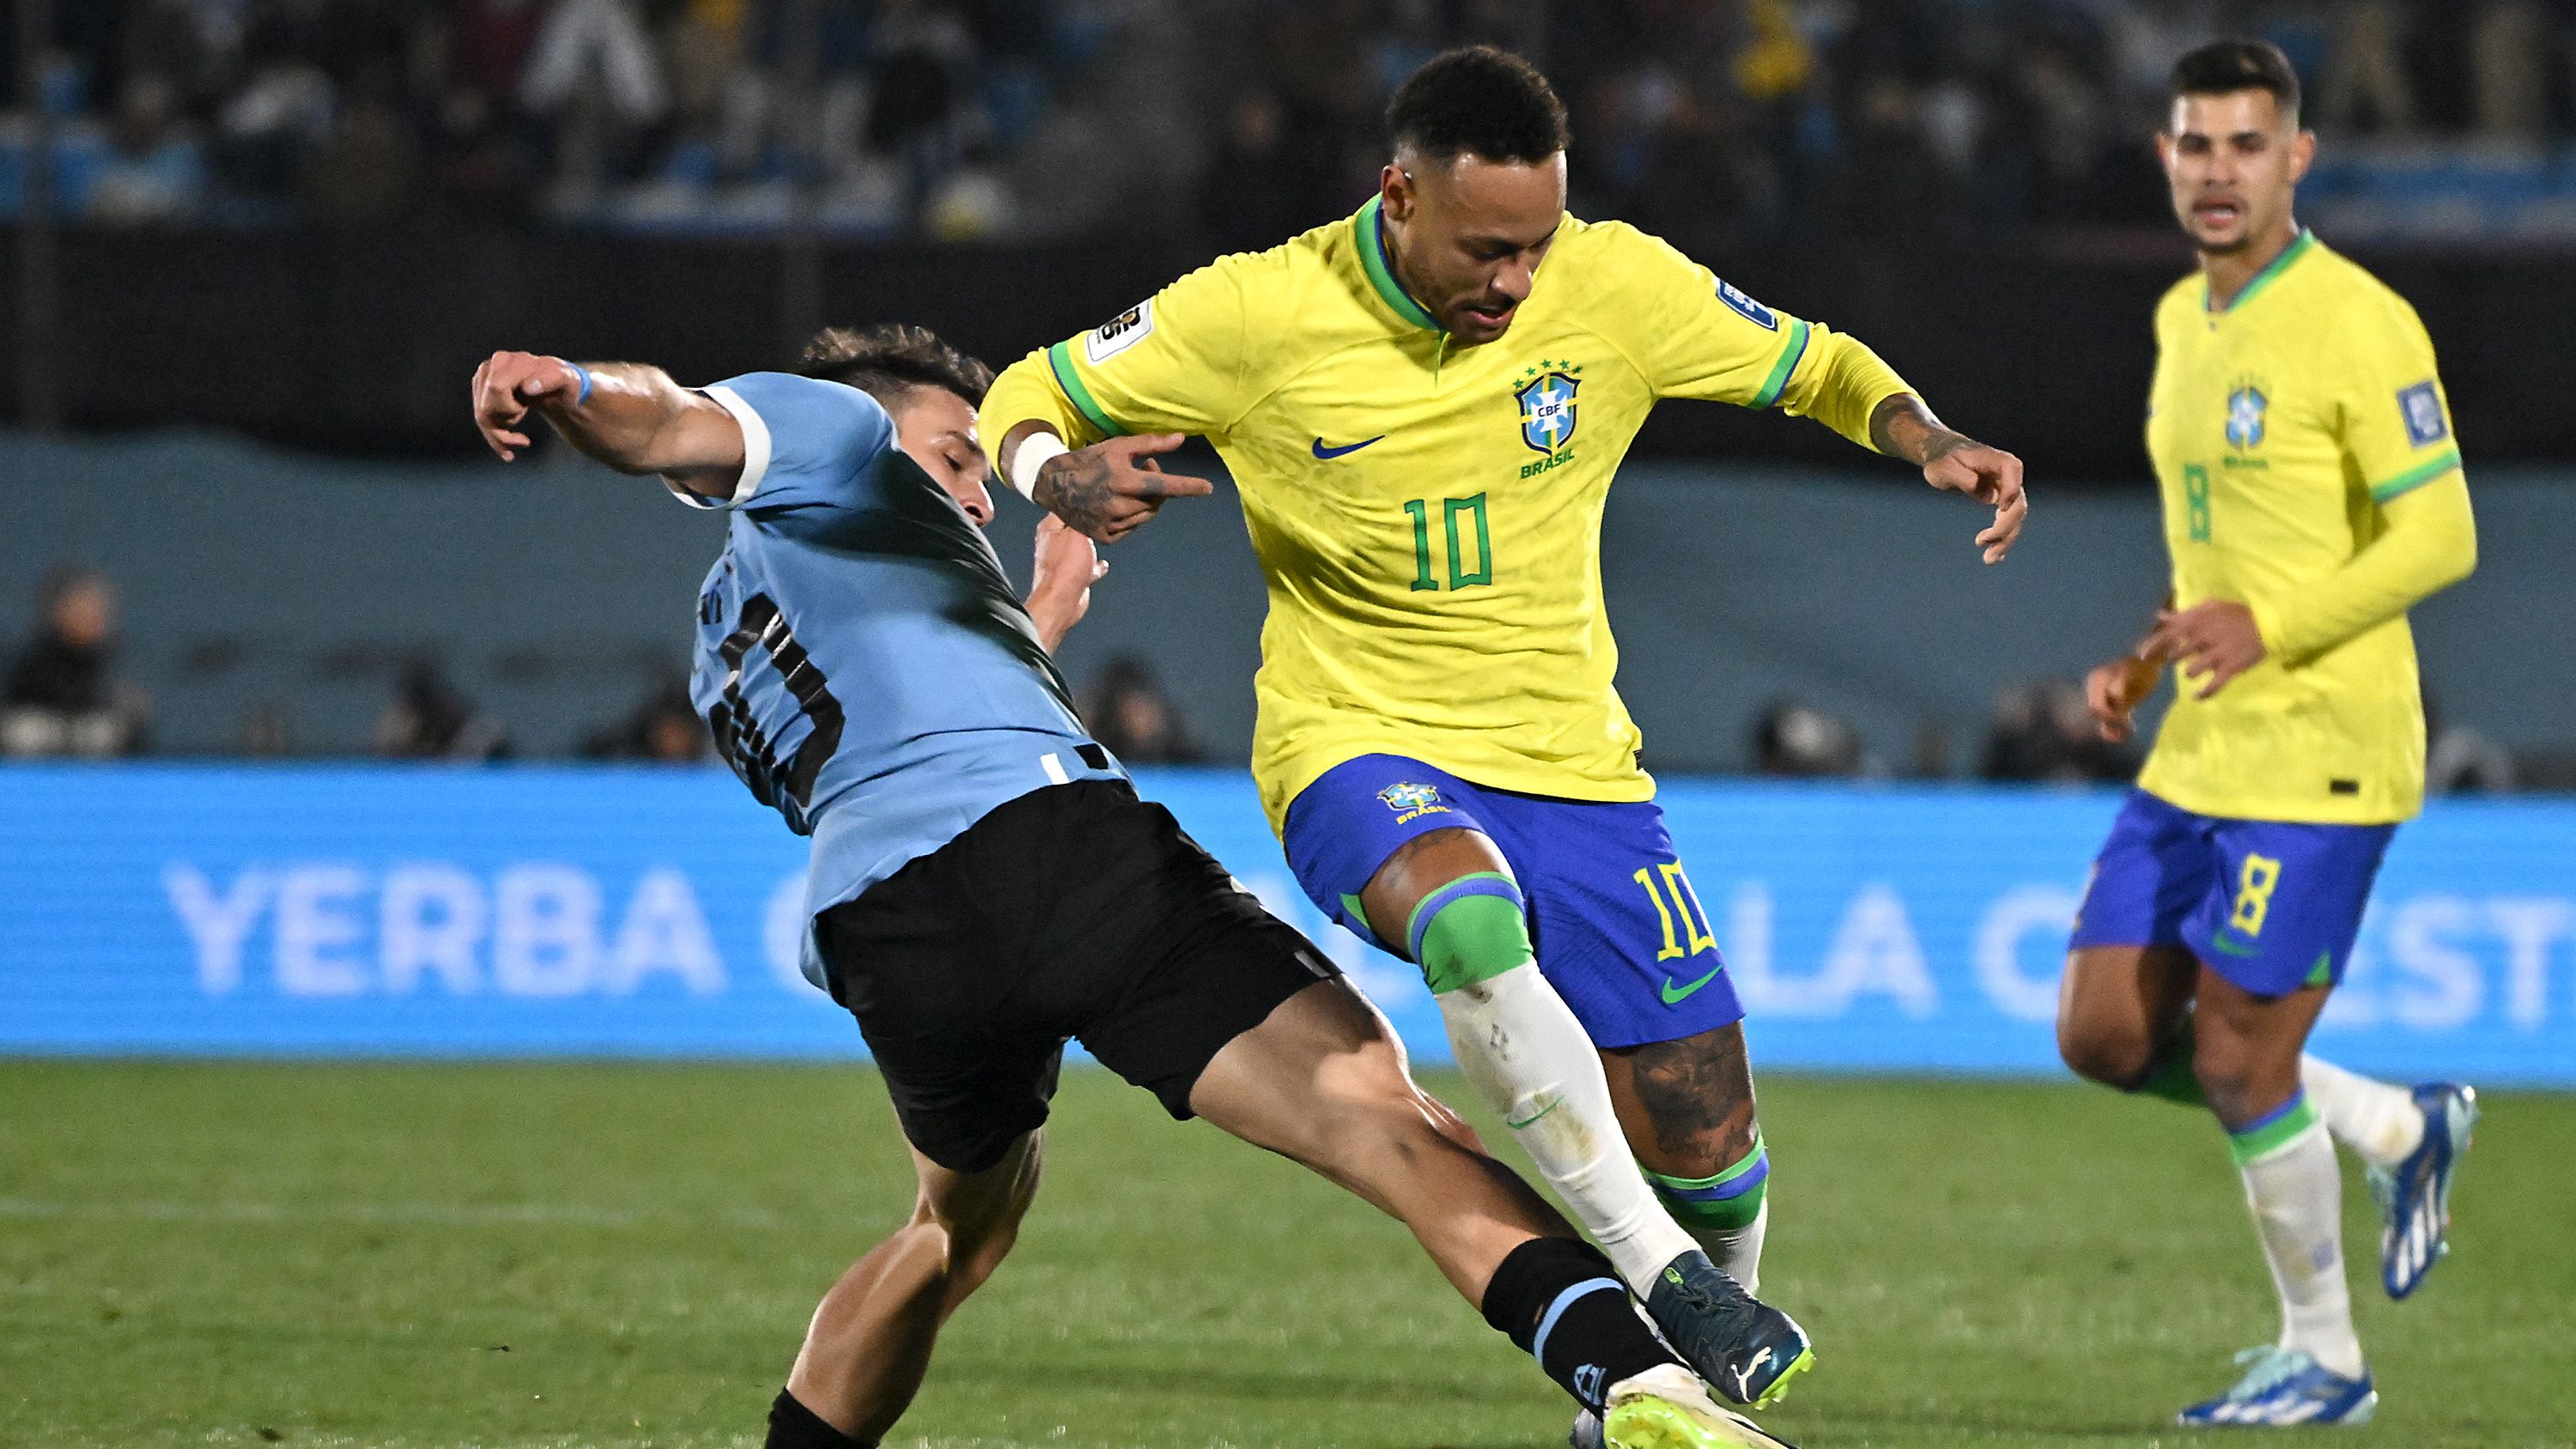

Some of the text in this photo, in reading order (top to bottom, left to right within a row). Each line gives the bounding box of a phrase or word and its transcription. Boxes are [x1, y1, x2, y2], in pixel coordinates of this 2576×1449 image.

[1538, 403, 1561, 417] CBF
[1520, 448, 1575, 479] BRASIL
[2184, 464, 2211, 543] 8
[1404, 492, 1492, 591] 10
[166, 865, 727, 996] YERBA
[1634, 858, 1718, 962] 10
[2233, 855, 2281, 937] 8
[1728, 882, 1935, 1020] LA
